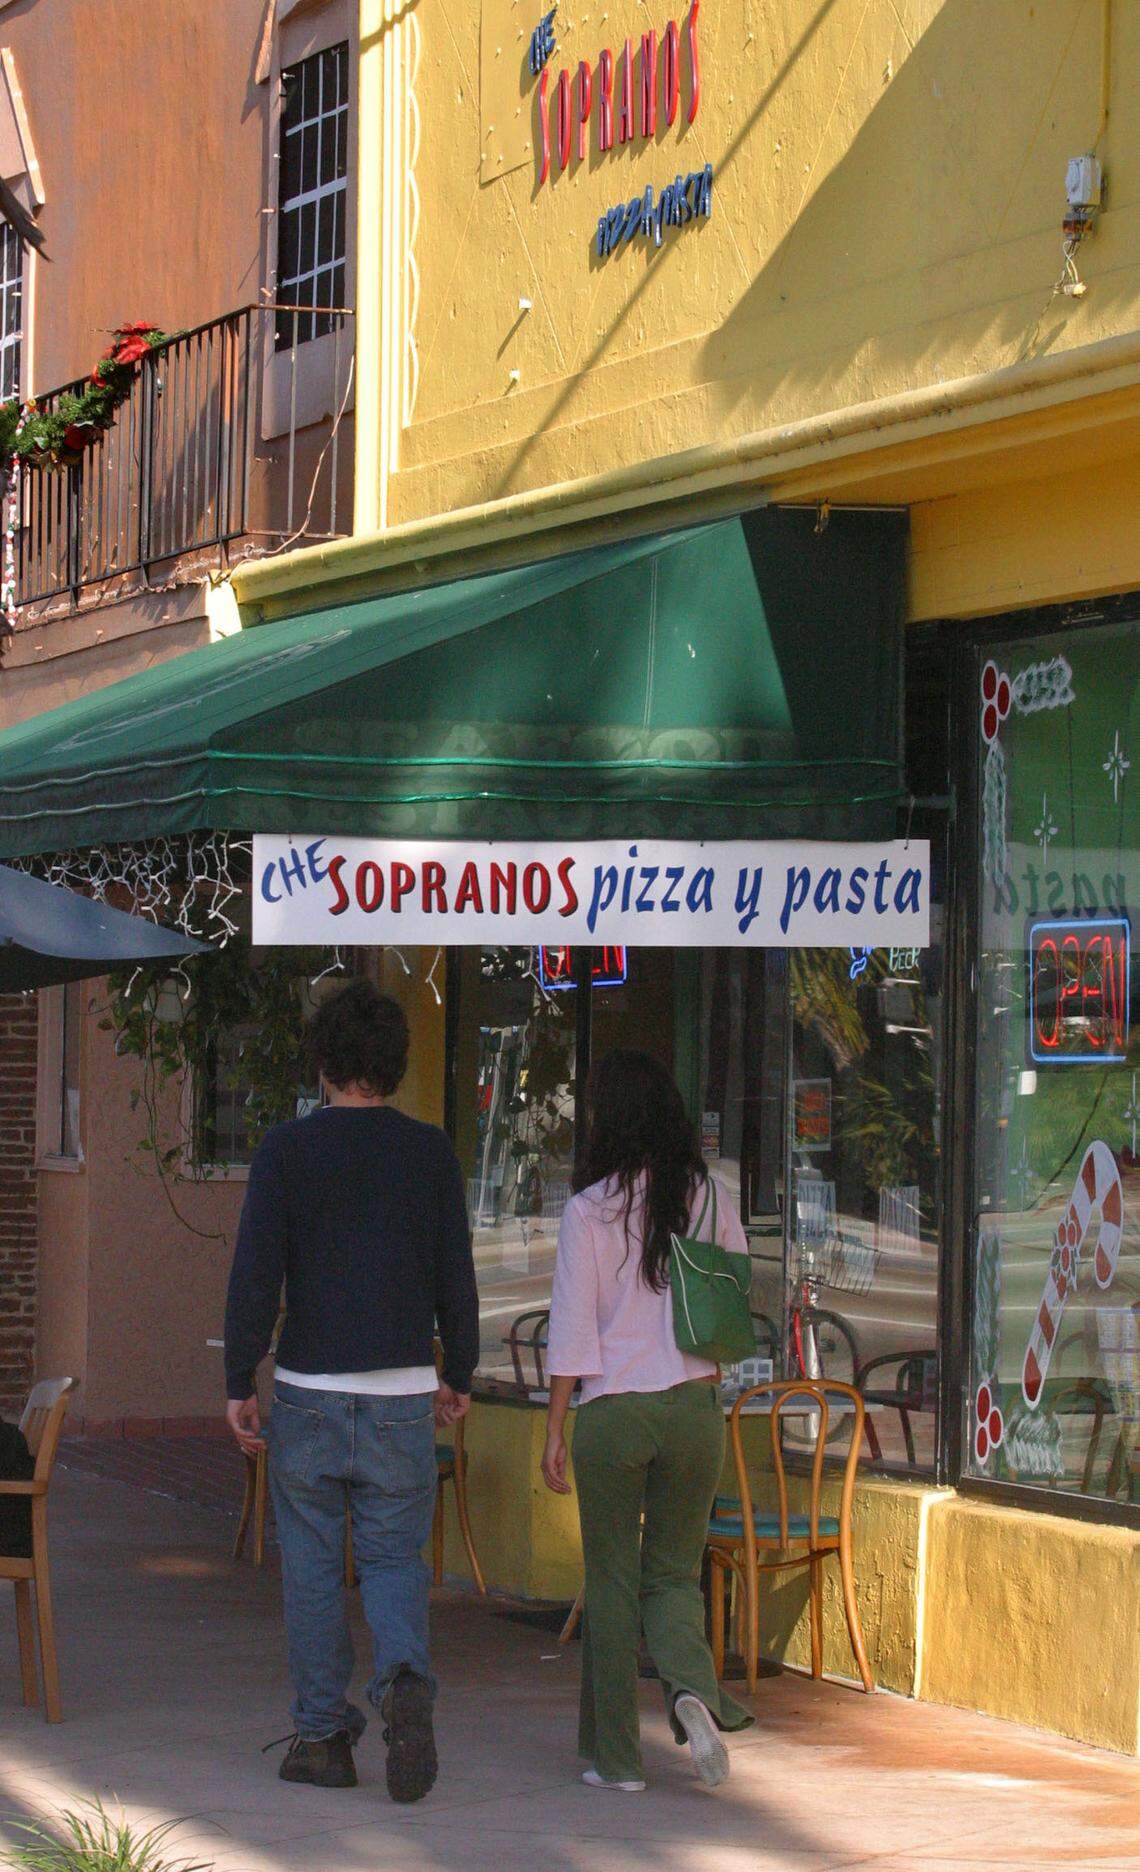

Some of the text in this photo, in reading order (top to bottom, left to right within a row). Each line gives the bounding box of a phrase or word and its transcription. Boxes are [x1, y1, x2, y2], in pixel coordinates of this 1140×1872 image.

[538, 0, 700, 185] SOPRANOS
[261, 838, 922, 935] CHE SOPRANOS pizza y pasta
[1034, 934, 1126, 1048] OPEN
